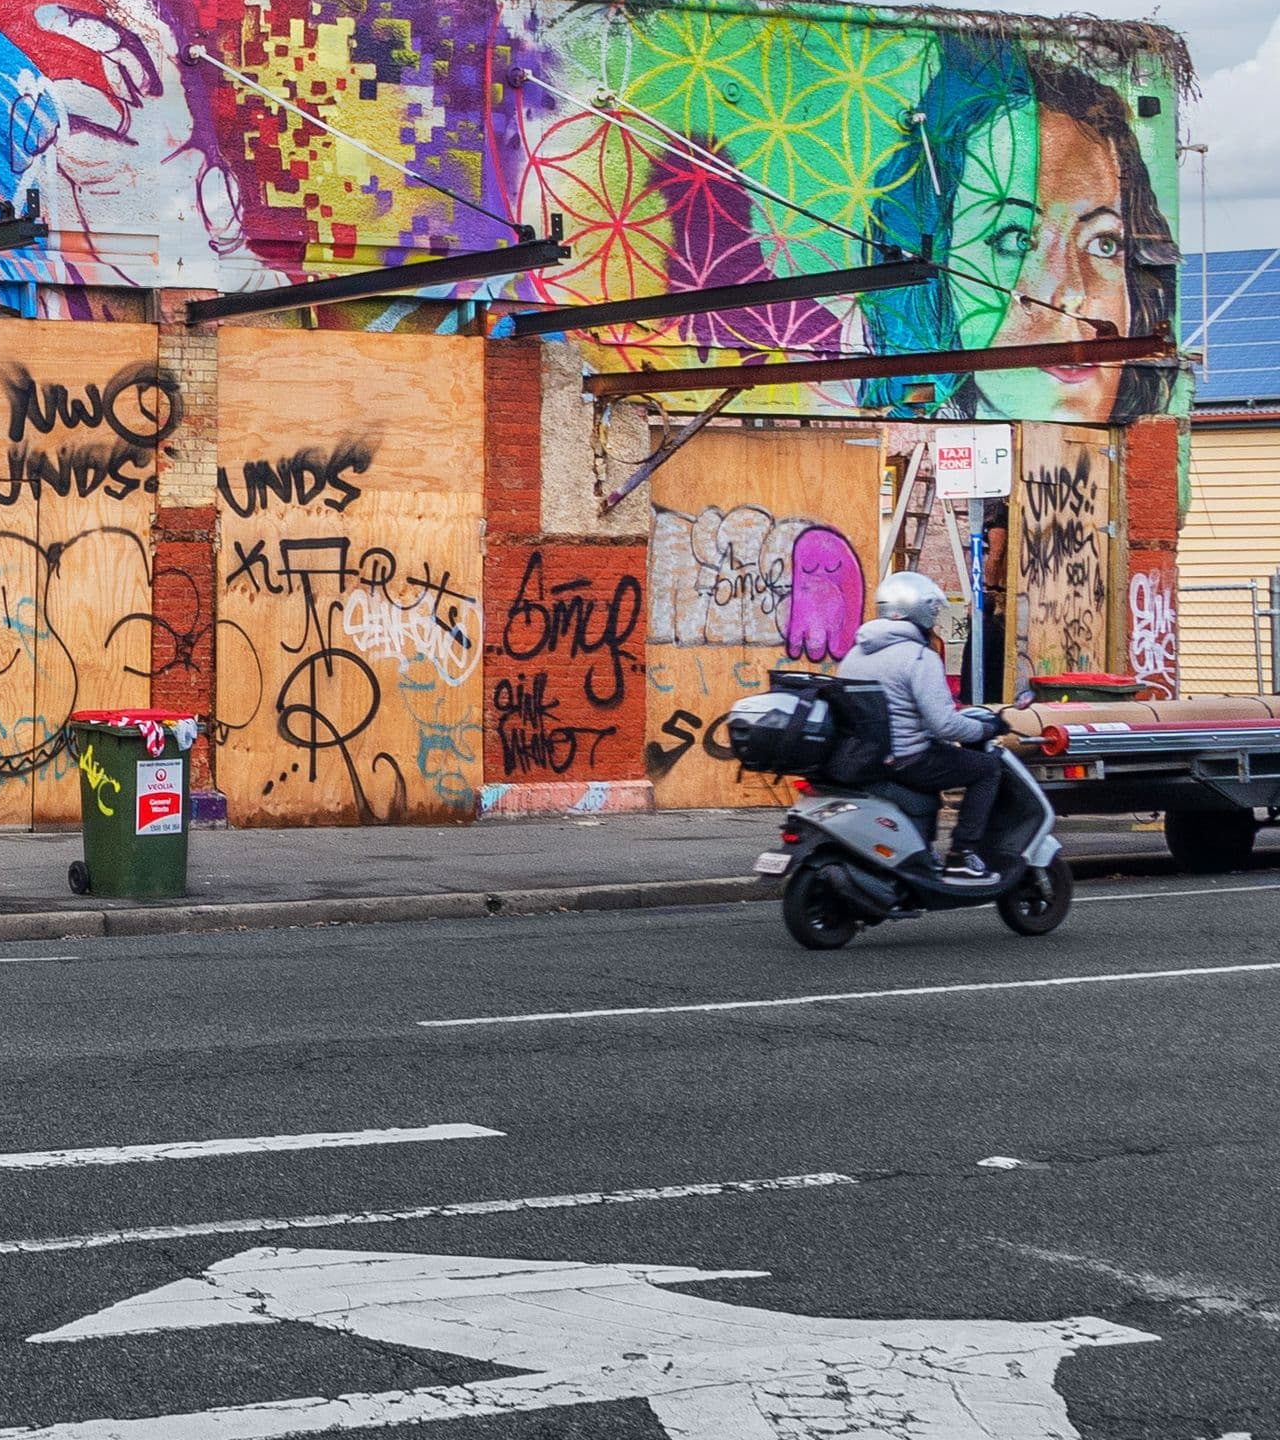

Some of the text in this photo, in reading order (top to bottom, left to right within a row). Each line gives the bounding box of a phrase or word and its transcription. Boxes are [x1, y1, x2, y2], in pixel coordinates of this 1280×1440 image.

[942, 448, 970, 458] TAXI
[995, 448, 1009, 465] P
[939, 459, 971, 469] ZONE
[972, 537, 983, 609] TAXI
